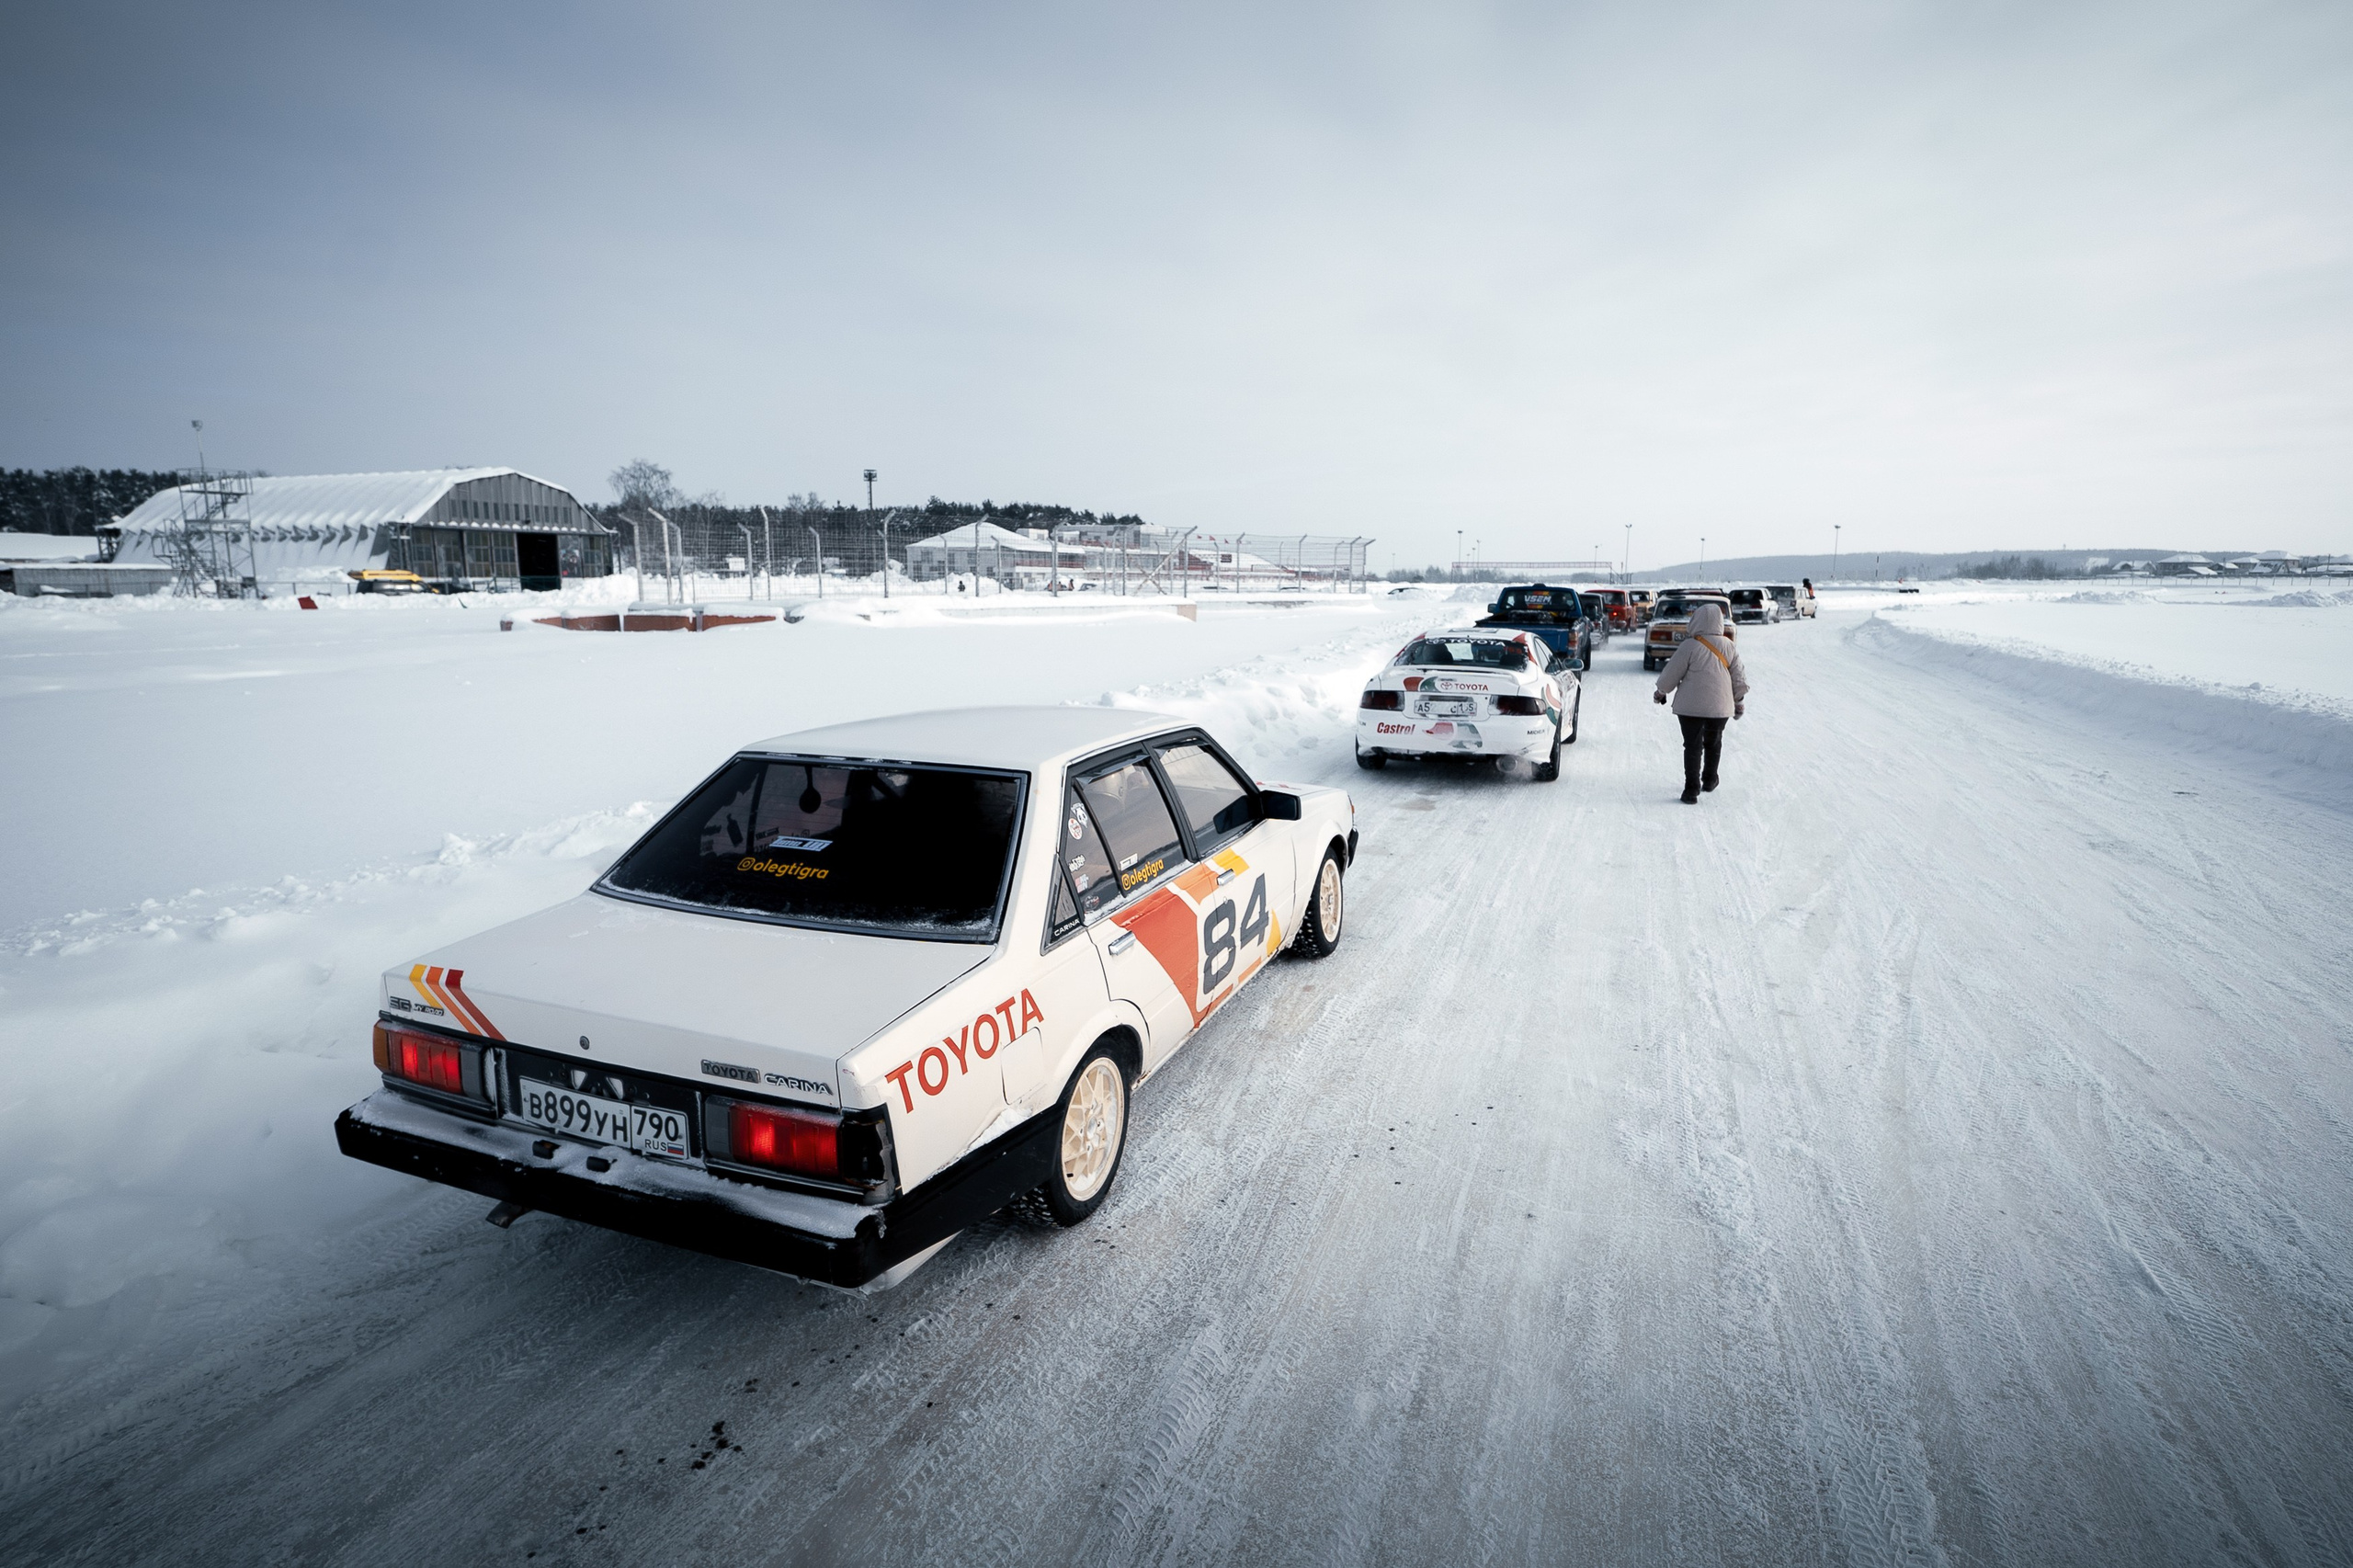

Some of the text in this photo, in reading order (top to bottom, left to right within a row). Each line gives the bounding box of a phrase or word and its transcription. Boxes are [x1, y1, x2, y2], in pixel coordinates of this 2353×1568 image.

[1449, 638, 1506, 647] TOYOTA
[1454, 683, 1489, 691] TOYOTA
[1377, 722, 1415, 735] Castrol
[1053, 918, 1080, 937] CARINA
[1203, 872, 1269, 994] 84
[884, 988, 1044, 1114] TOYOTA
[703, 1062, 833, 1096] TOYOTA CARINA
[633, 1108, 679, 1142] 790
[644, 1139, 666, 1152] RUS
